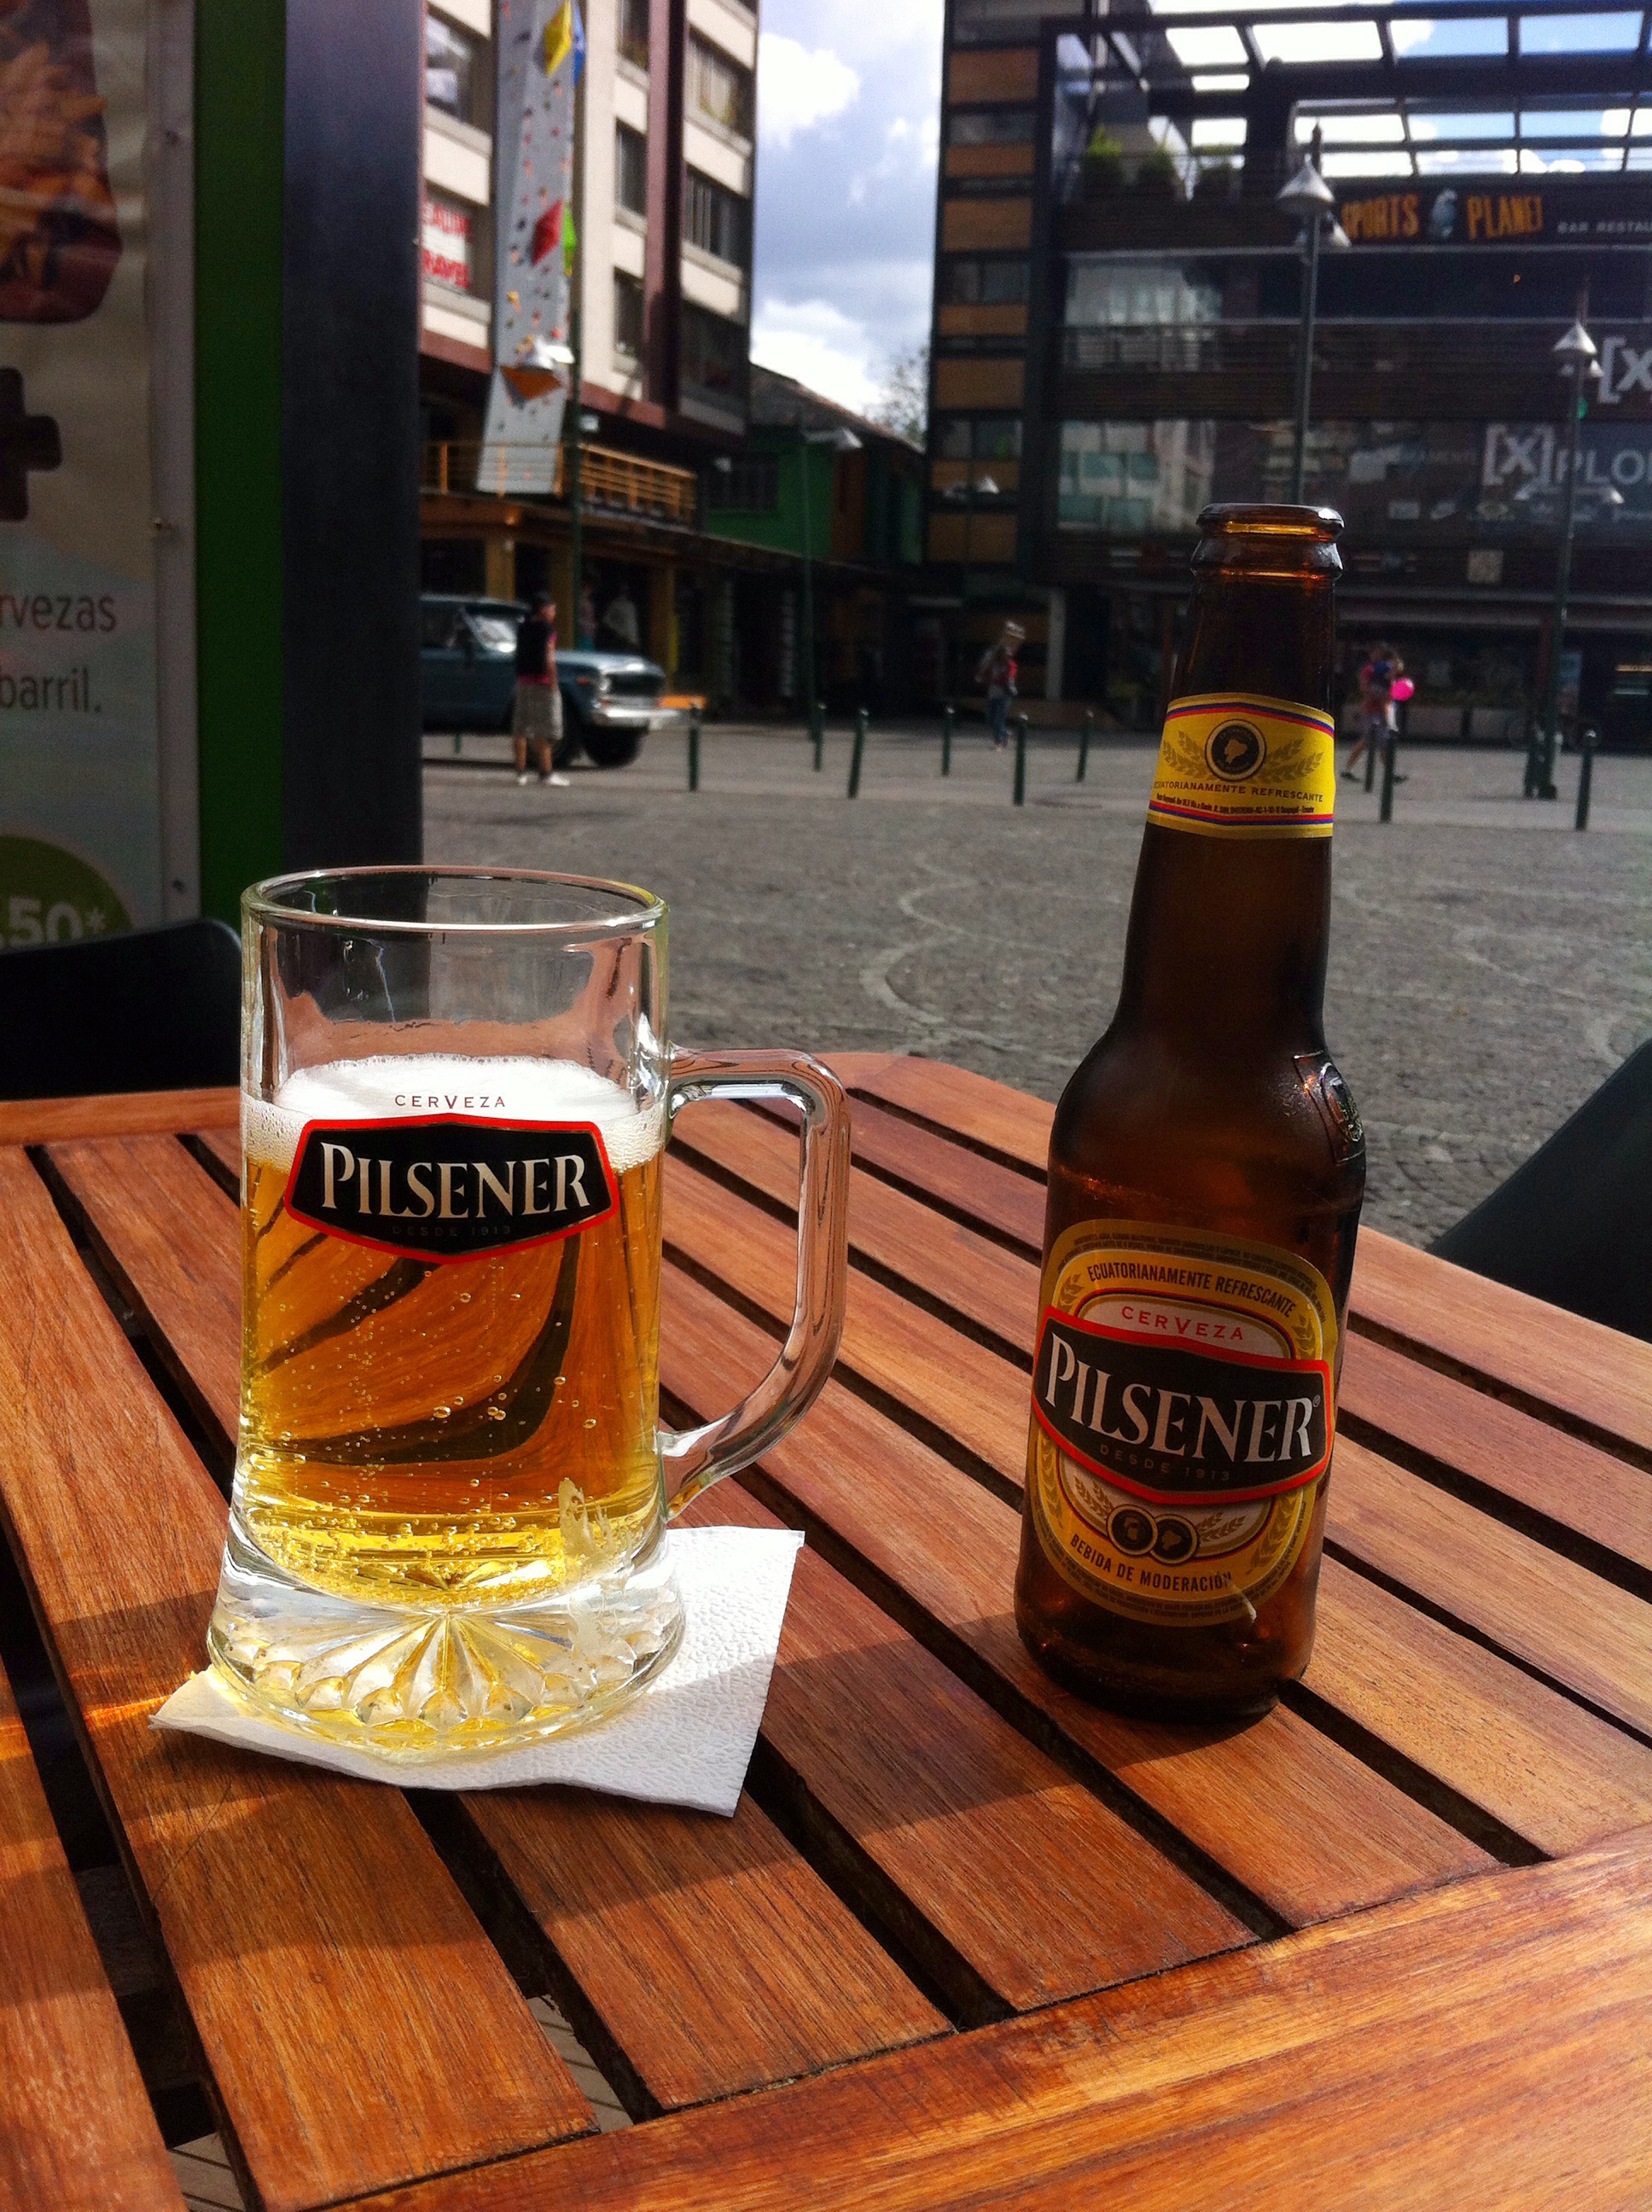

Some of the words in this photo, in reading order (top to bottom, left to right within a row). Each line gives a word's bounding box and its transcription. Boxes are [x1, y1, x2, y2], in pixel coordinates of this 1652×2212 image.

[1252, 785, 1323, 802] REFRESCANTE
[395, 1095, 505, 1109] CERVEZA
[320, 1142, 590, 1219] PILSENER
[392, 1225, 458, 1237] DESDE
[1087, 1262, 1213, 1289] ECUATORIANAMENTE
[1215, 1276, 1296, 1318] REFRESCANTE
[1121, 1306, 1244, 1341] CERVEZA
[1045, 1332, 1314, 1463] PILSENER
[1100, 1444, 1170, 1474] DESDE
[1185, 1467, 1230, 1481] 1913
[1070, 1534, 1111, 1573] BEBIDA
[1115, 1563, 1134, 1581] DE
[1140, 1570, 1231, 1592] MODERACIÓN
